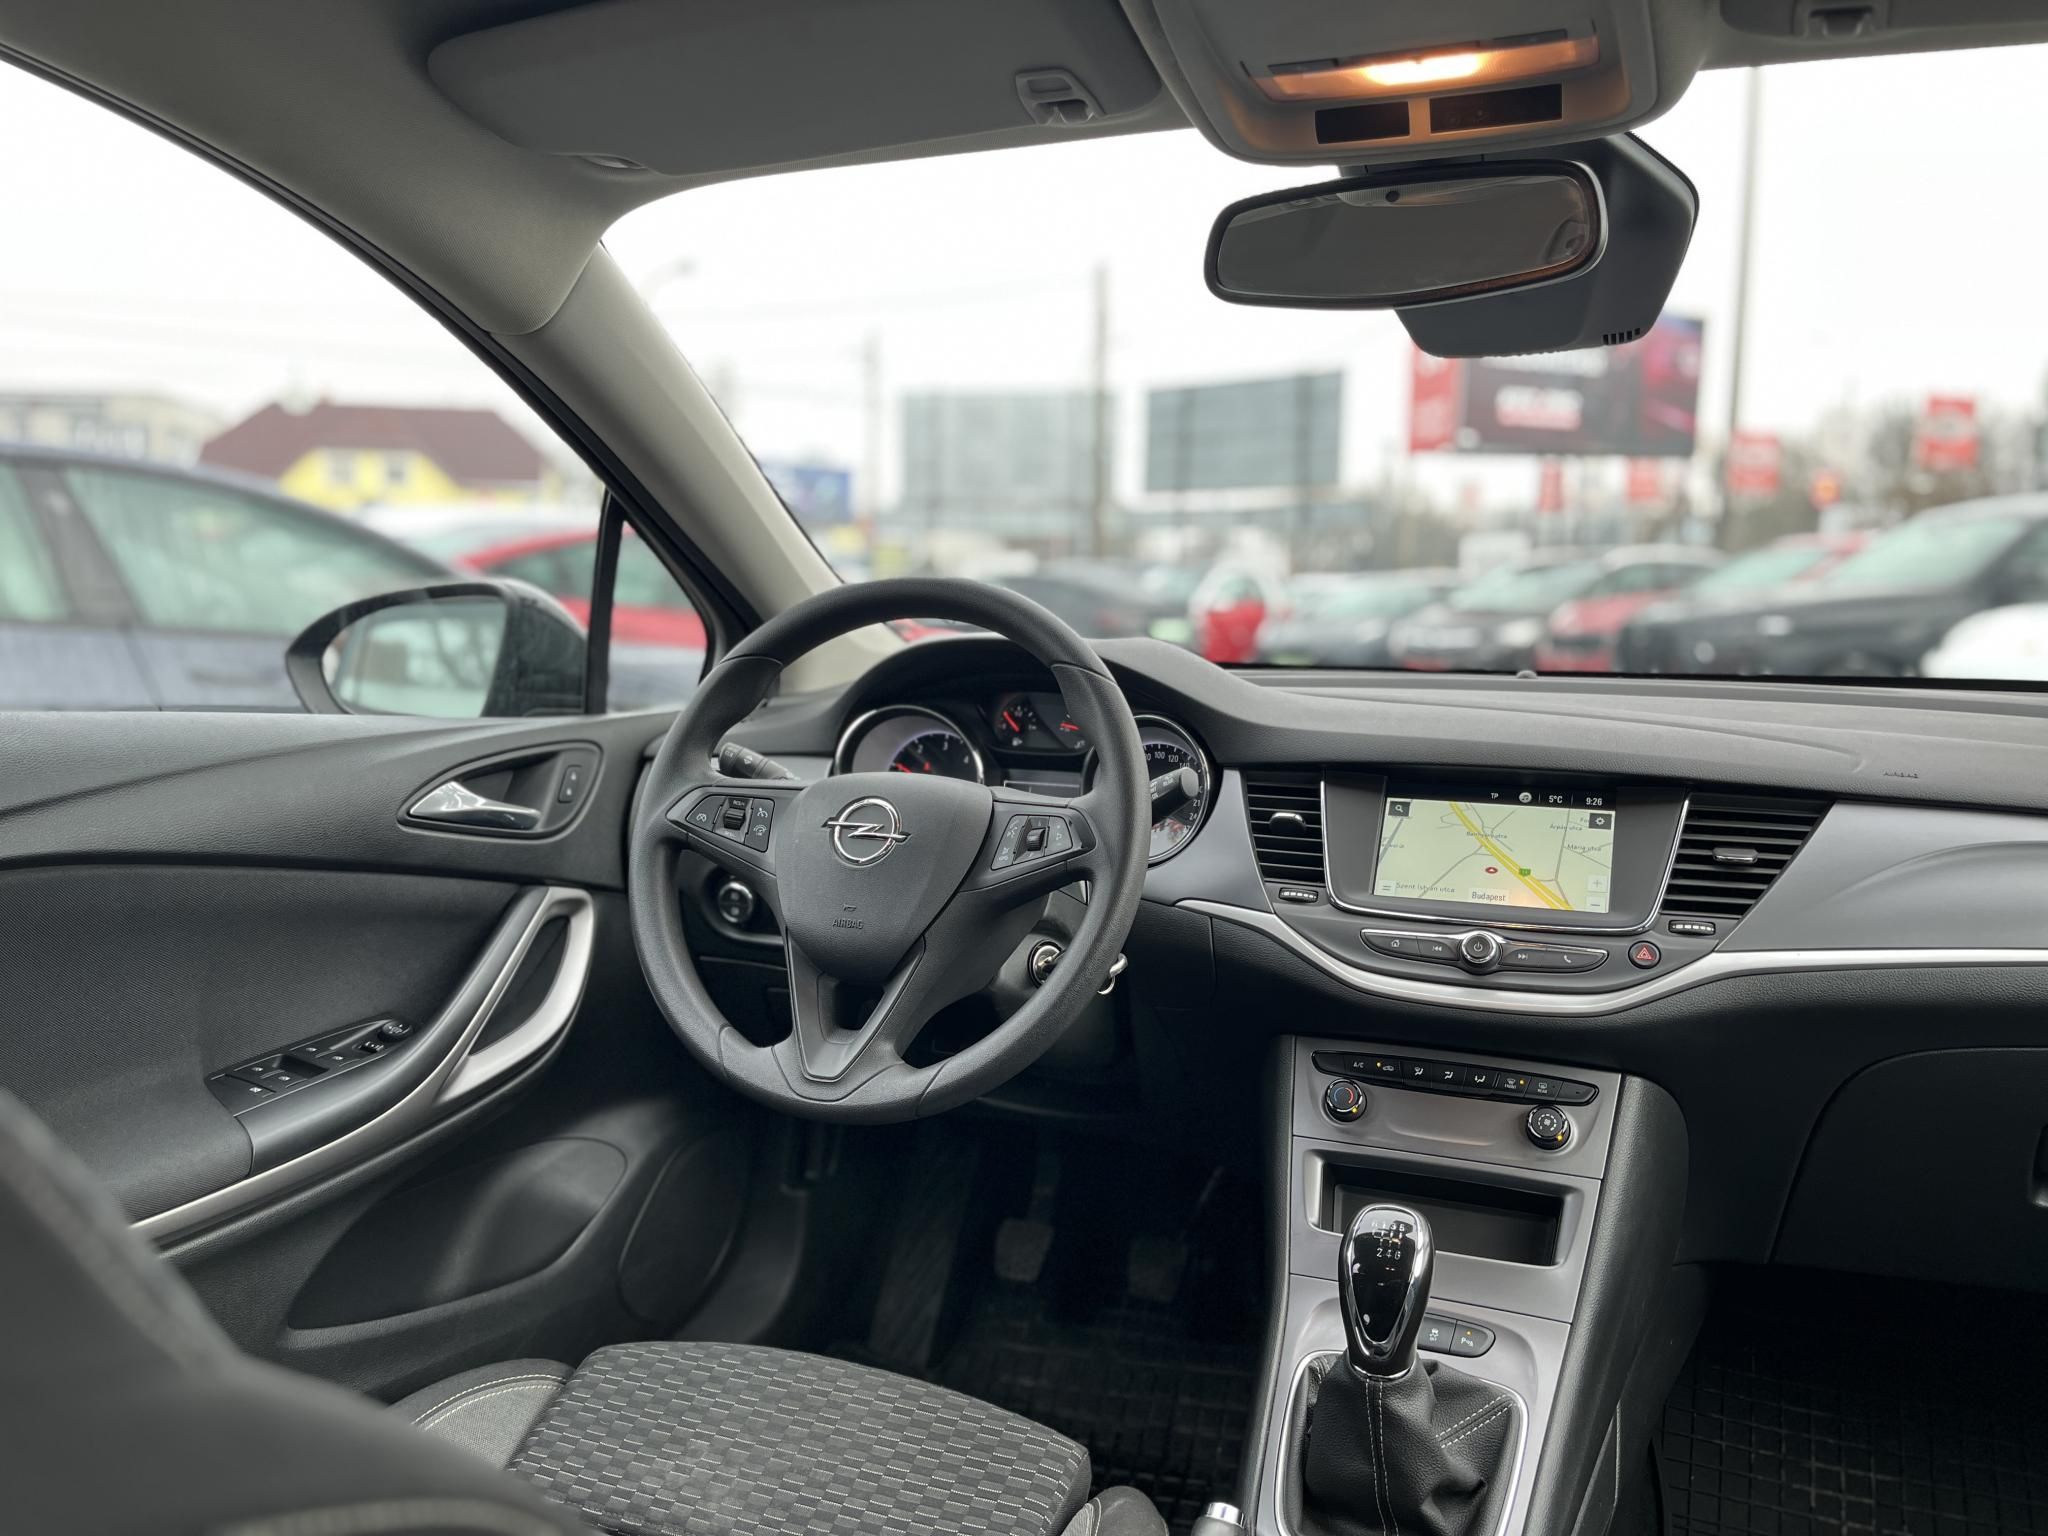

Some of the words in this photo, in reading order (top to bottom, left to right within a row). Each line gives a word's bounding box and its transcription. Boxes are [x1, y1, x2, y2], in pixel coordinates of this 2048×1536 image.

[1154, 751, 1166, 760] 100
[1168, 754, 1179, 763] 120
[1490, 792, 1499, 800] TP
[1548, 795, 1563, 804] 5°C
[1585, 797, 1603, 806] 9:26
[1471, 891, 1507, 903] Budapest
[832, 919, 864, 930] AIRBAG
[1353, 1061, 1364, 1069] A/C
[1390, 1222, 1397, 1230] 3
[1399, 1223, 1405, 1232] 5
[1376, 1247, 1383, 1258] 2
[1385, 1249, 1392, 1259] 4
